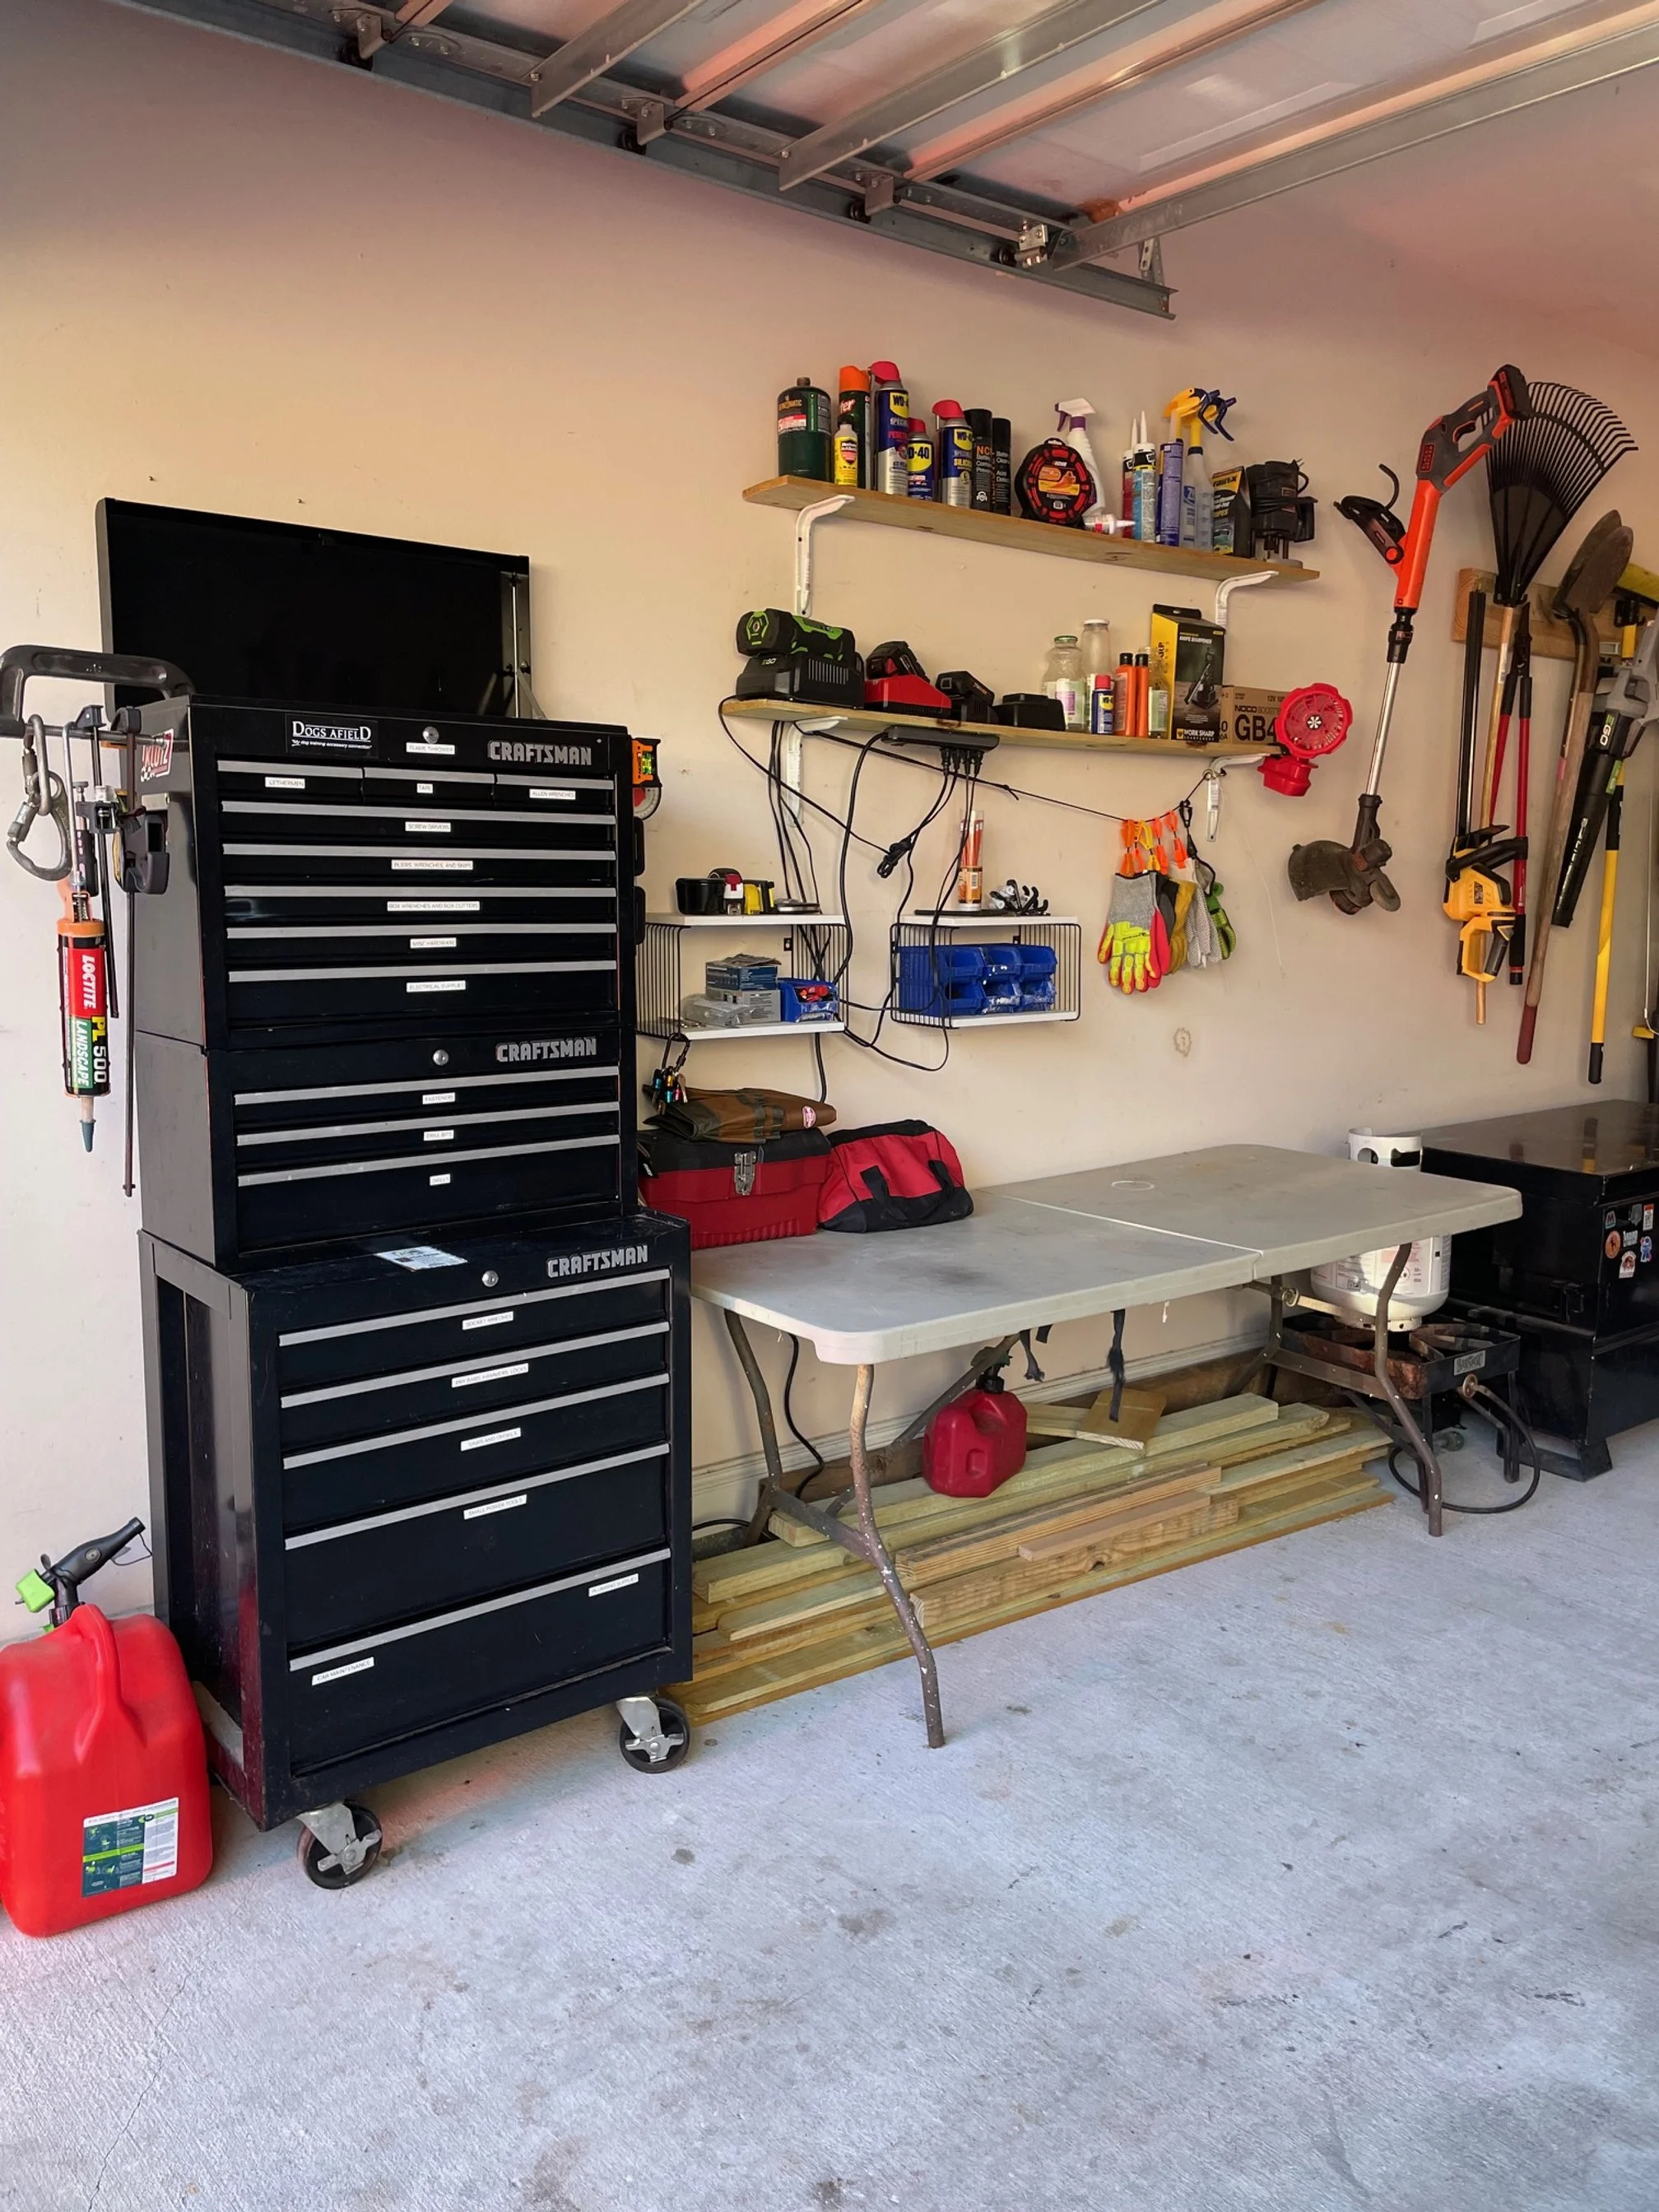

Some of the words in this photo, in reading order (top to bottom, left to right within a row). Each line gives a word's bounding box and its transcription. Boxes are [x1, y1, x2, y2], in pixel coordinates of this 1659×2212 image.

[908, 446, 930, 460] D-40
[1234, 704, 1257, 713] NOCO
[291, 720, 328, 737] DOGS
[329, 726, 372, 741] AFIELD
[1199, 729, 1215, 737] SHARP
[1234, 713, 1279, 741] GB4
[1599, 713, 1615, 746] EGO
[487, 740, 592, 766] CRAFTSMAN
[81, 954, 98, 1011] LOCTITE
[91, 1015, 106, 1043] PL
[75, 1019, 90, 1087] LANDSCAPE
[496, 1037, 597, 1062] CRAFTSMAN
[92, 1044, 108, 1084] 500
[546, 1243, 648, 1278] CRAFTSMAN
[317, 1673, 329, 1681] CAR
[330, 1660, 370, 1676] MAINTENANCE
